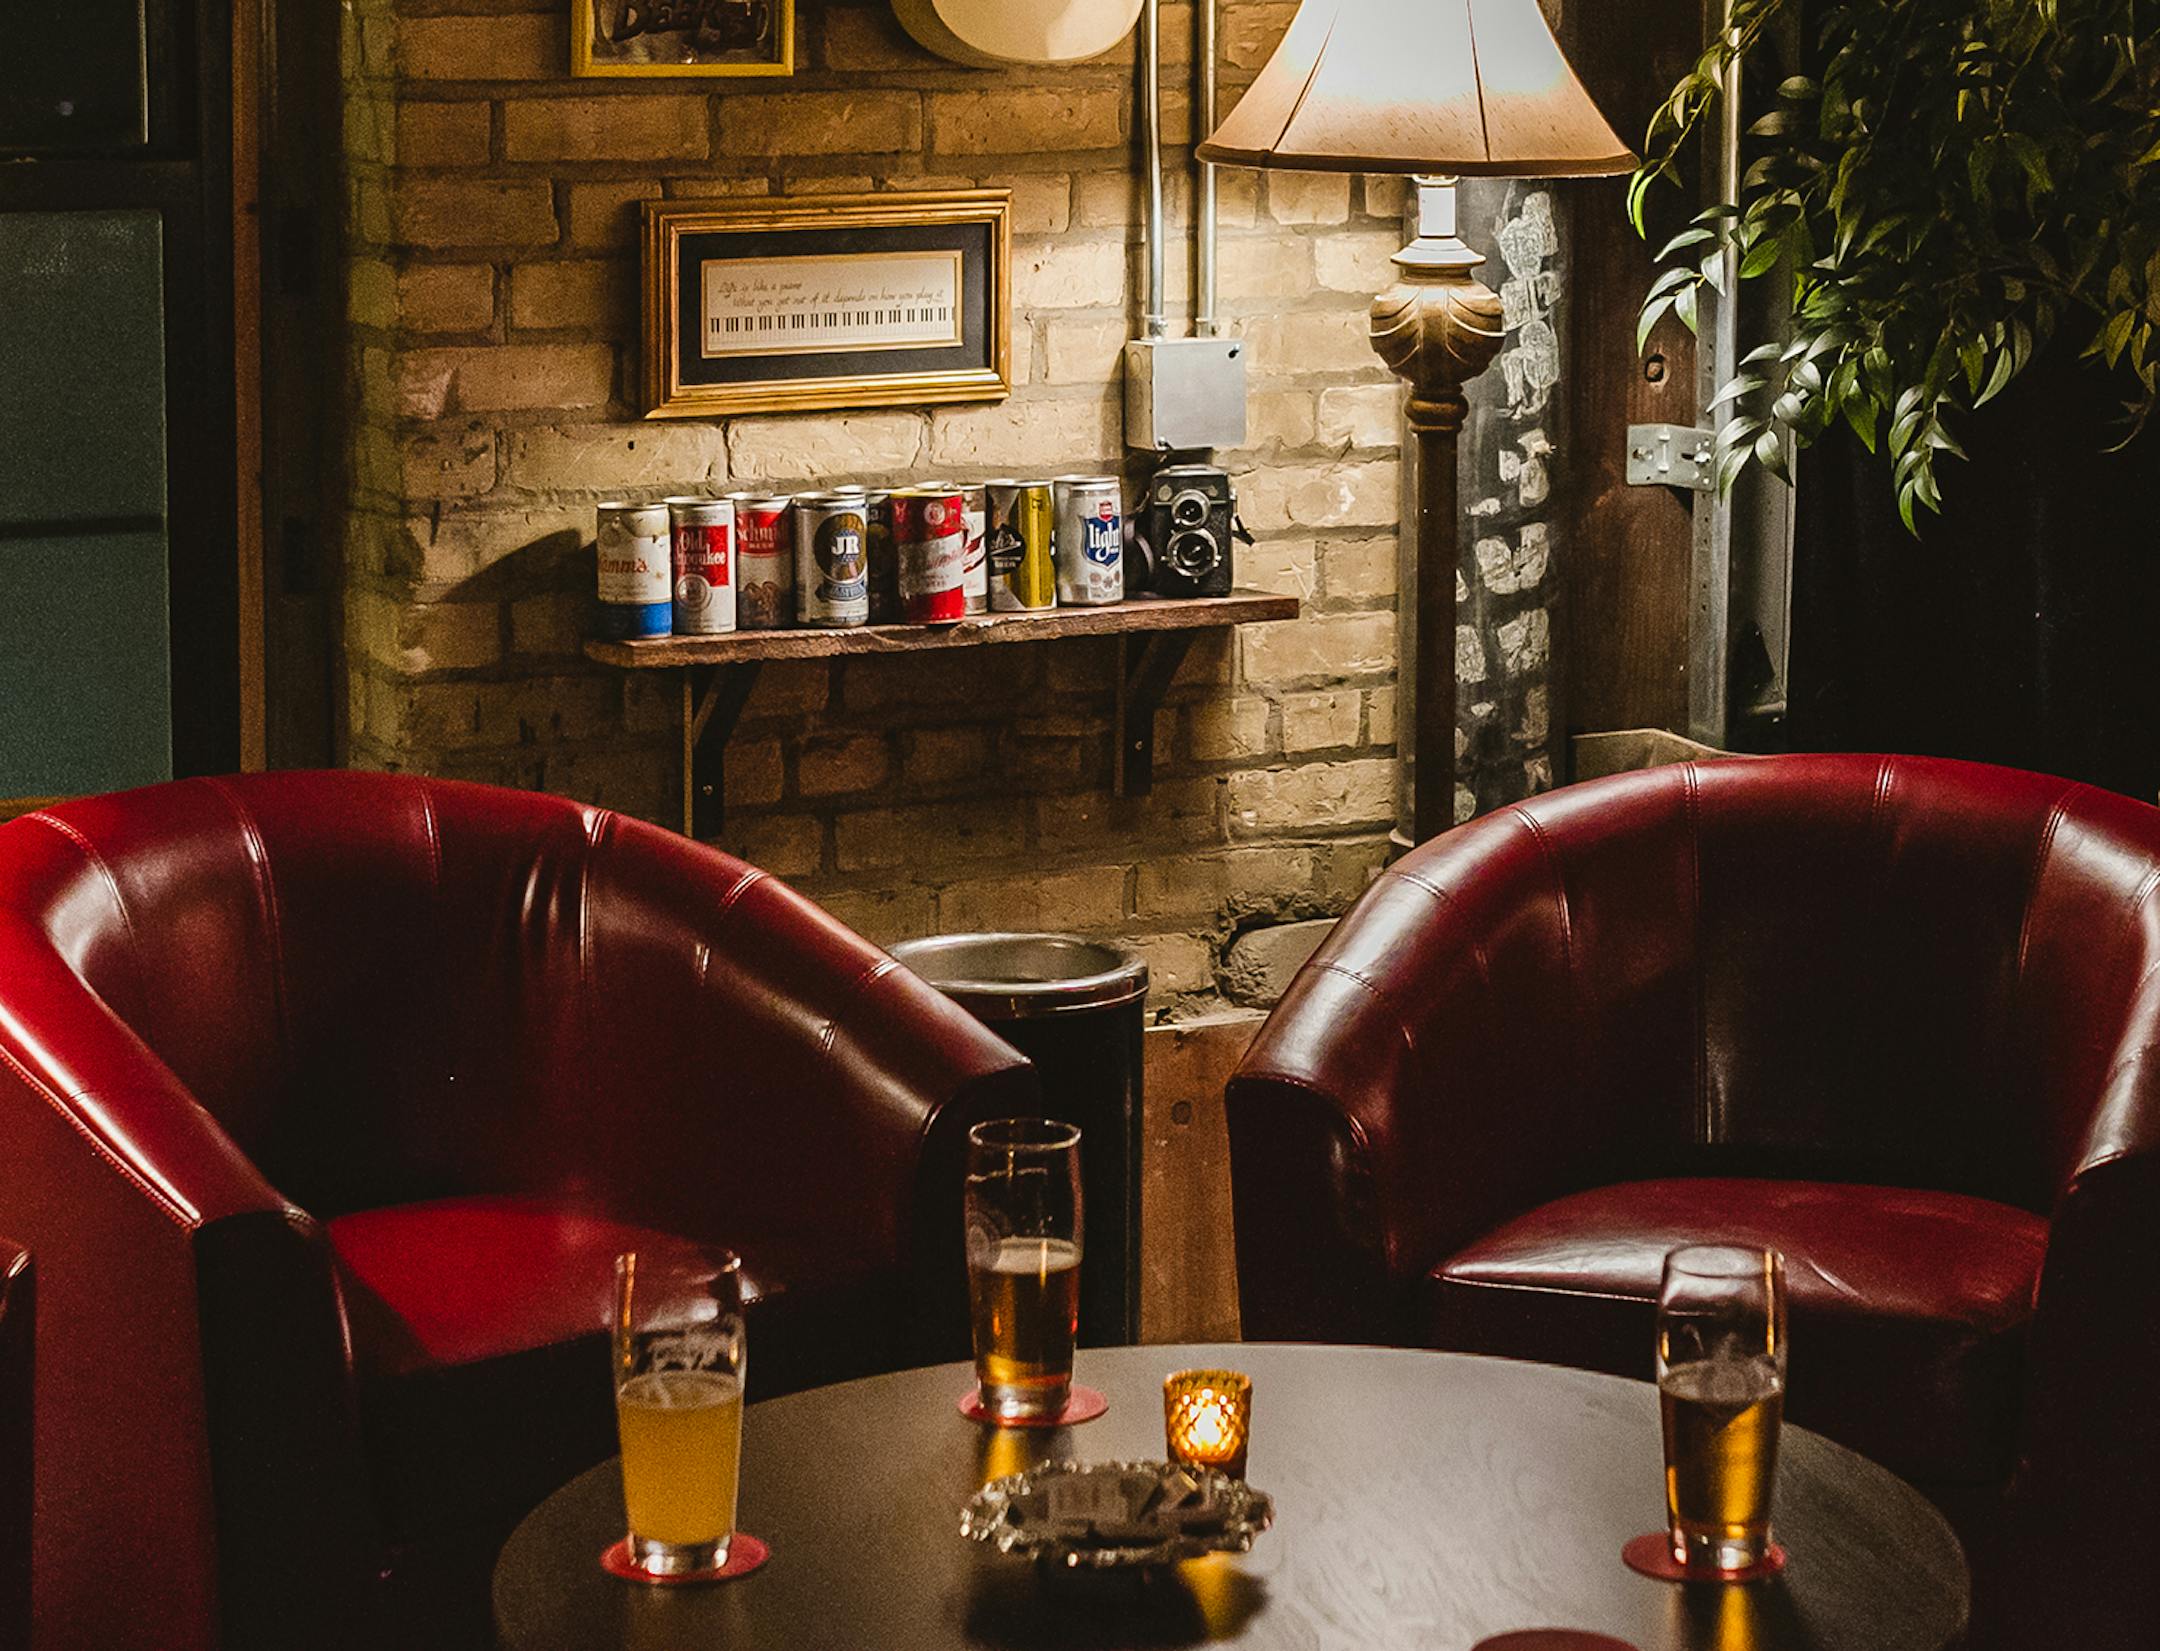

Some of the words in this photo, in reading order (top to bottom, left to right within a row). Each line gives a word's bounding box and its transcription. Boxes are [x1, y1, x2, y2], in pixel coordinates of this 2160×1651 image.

[757, 299, 773, 313] you
[810, 292, 819, 309] of
[915, 285, 934, 305] play
[680, 530, 705, 552] Old
[831, 534, 860, 555] JR
[600, 556, 647, 574] amm's
